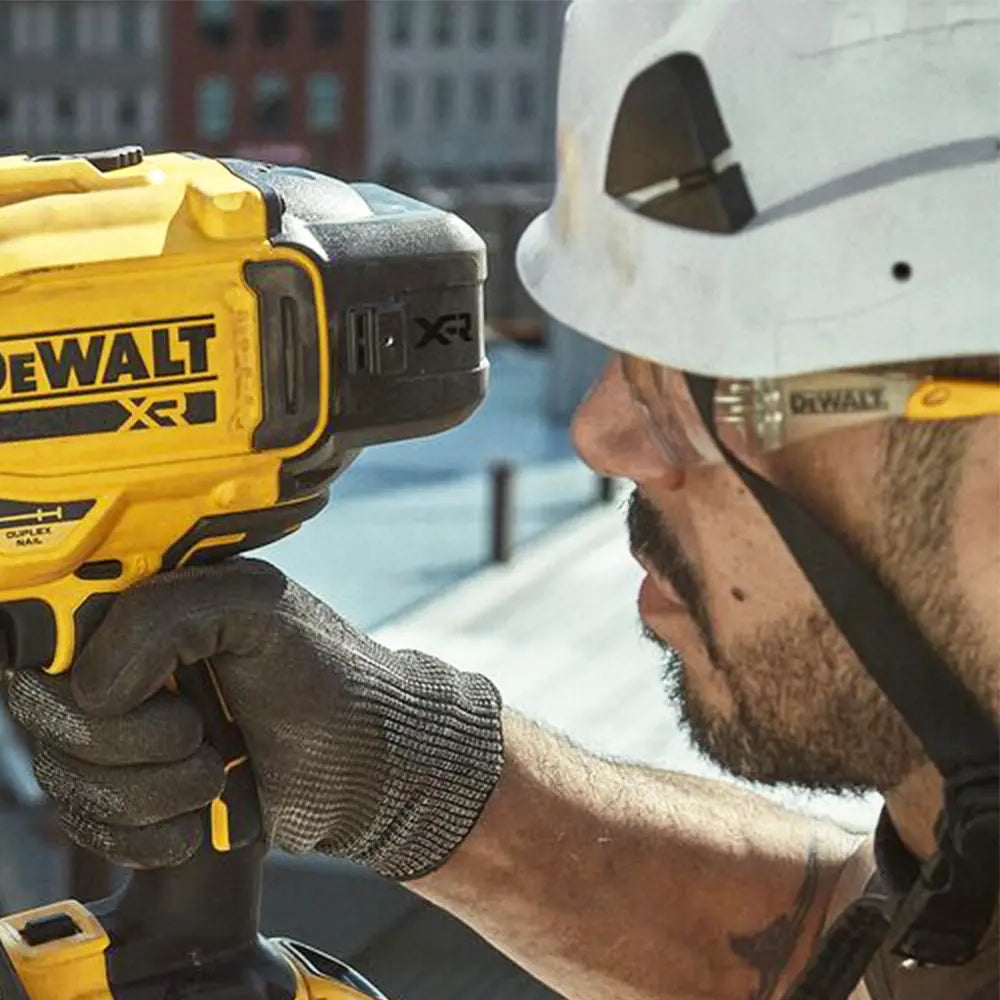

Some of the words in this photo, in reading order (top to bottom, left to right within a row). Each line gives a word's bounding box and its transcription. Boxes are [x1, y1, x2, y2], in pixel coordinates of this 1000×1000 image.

[414, 312, 473, 349] XR
[116, 394, 190, 432] XR
[6, 526, 51, 539] DUPLEX
